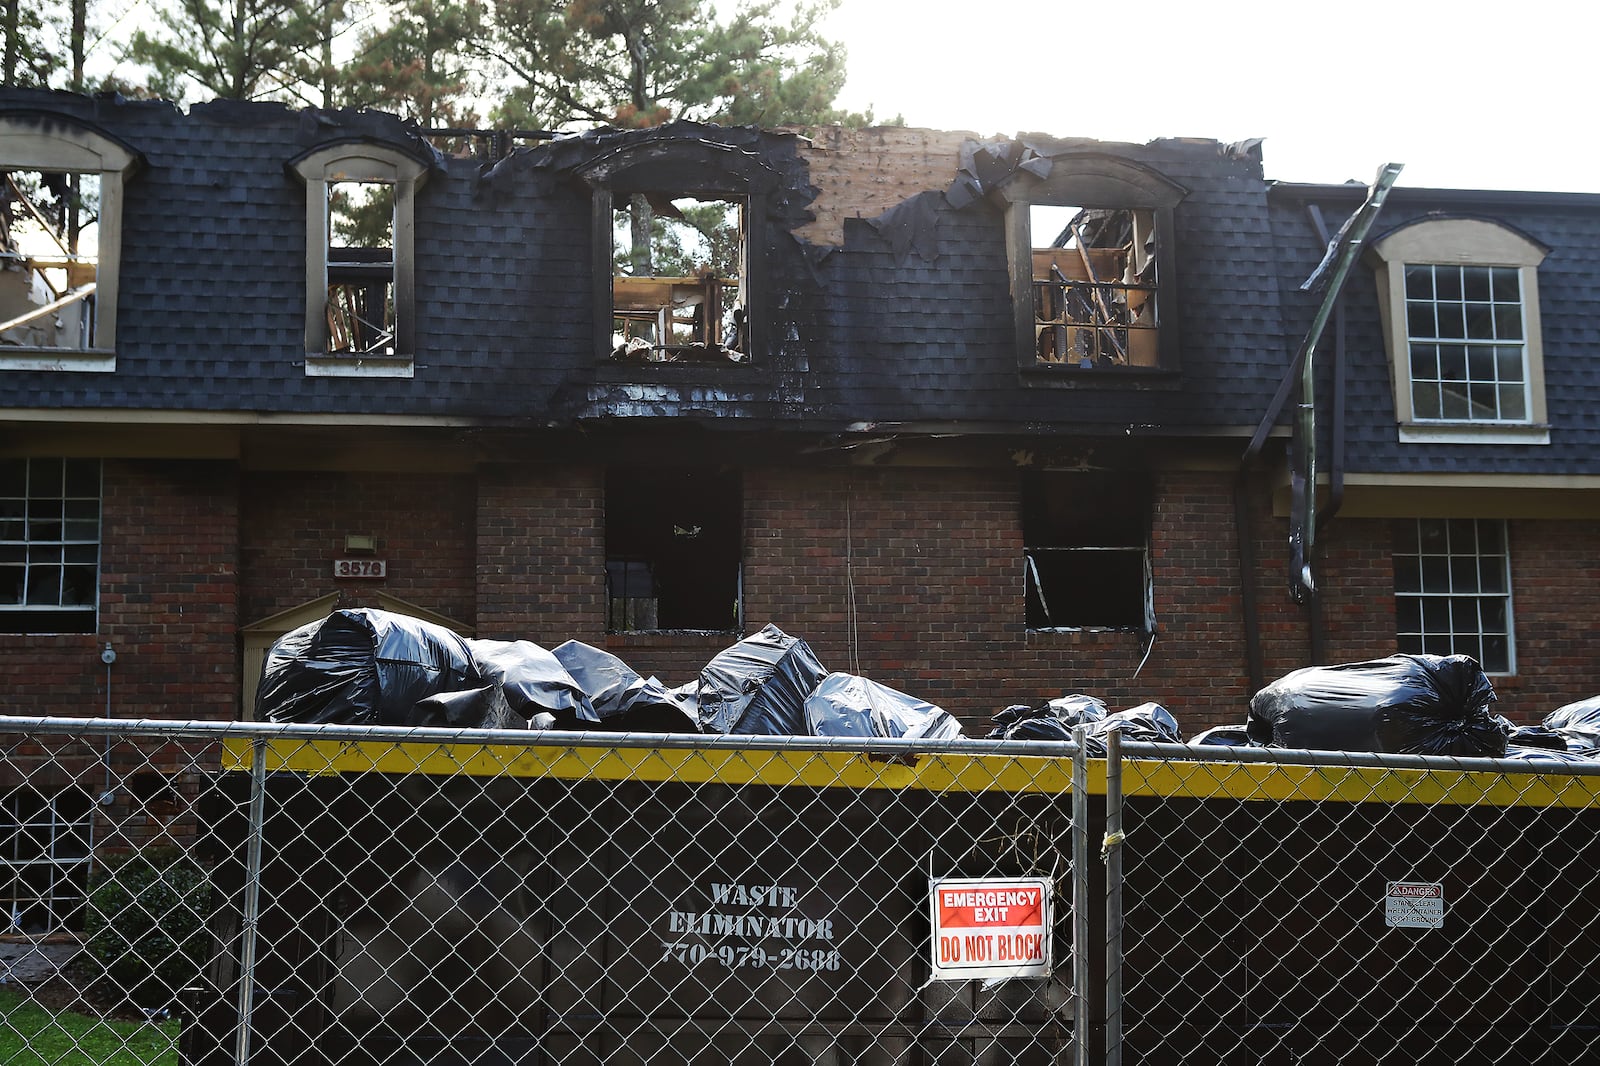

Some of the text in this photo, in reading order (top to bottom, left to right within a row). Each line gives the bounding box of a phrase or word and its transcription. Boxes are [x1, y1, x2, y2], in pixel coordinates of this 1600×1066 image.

[711, 882, 798, 908] WASTE
[943, 891, 1037, 908] EMERGENCY
[1402, 887, 1436, 896] DANGER
[668, 911, 834, 940] ELIMINATOR
[974, 907, 1009, 923] EXIT
[660, 942, 841, 972] 770-979-2688
[940, 933, 1043, 963] DO NOT BLOCK
